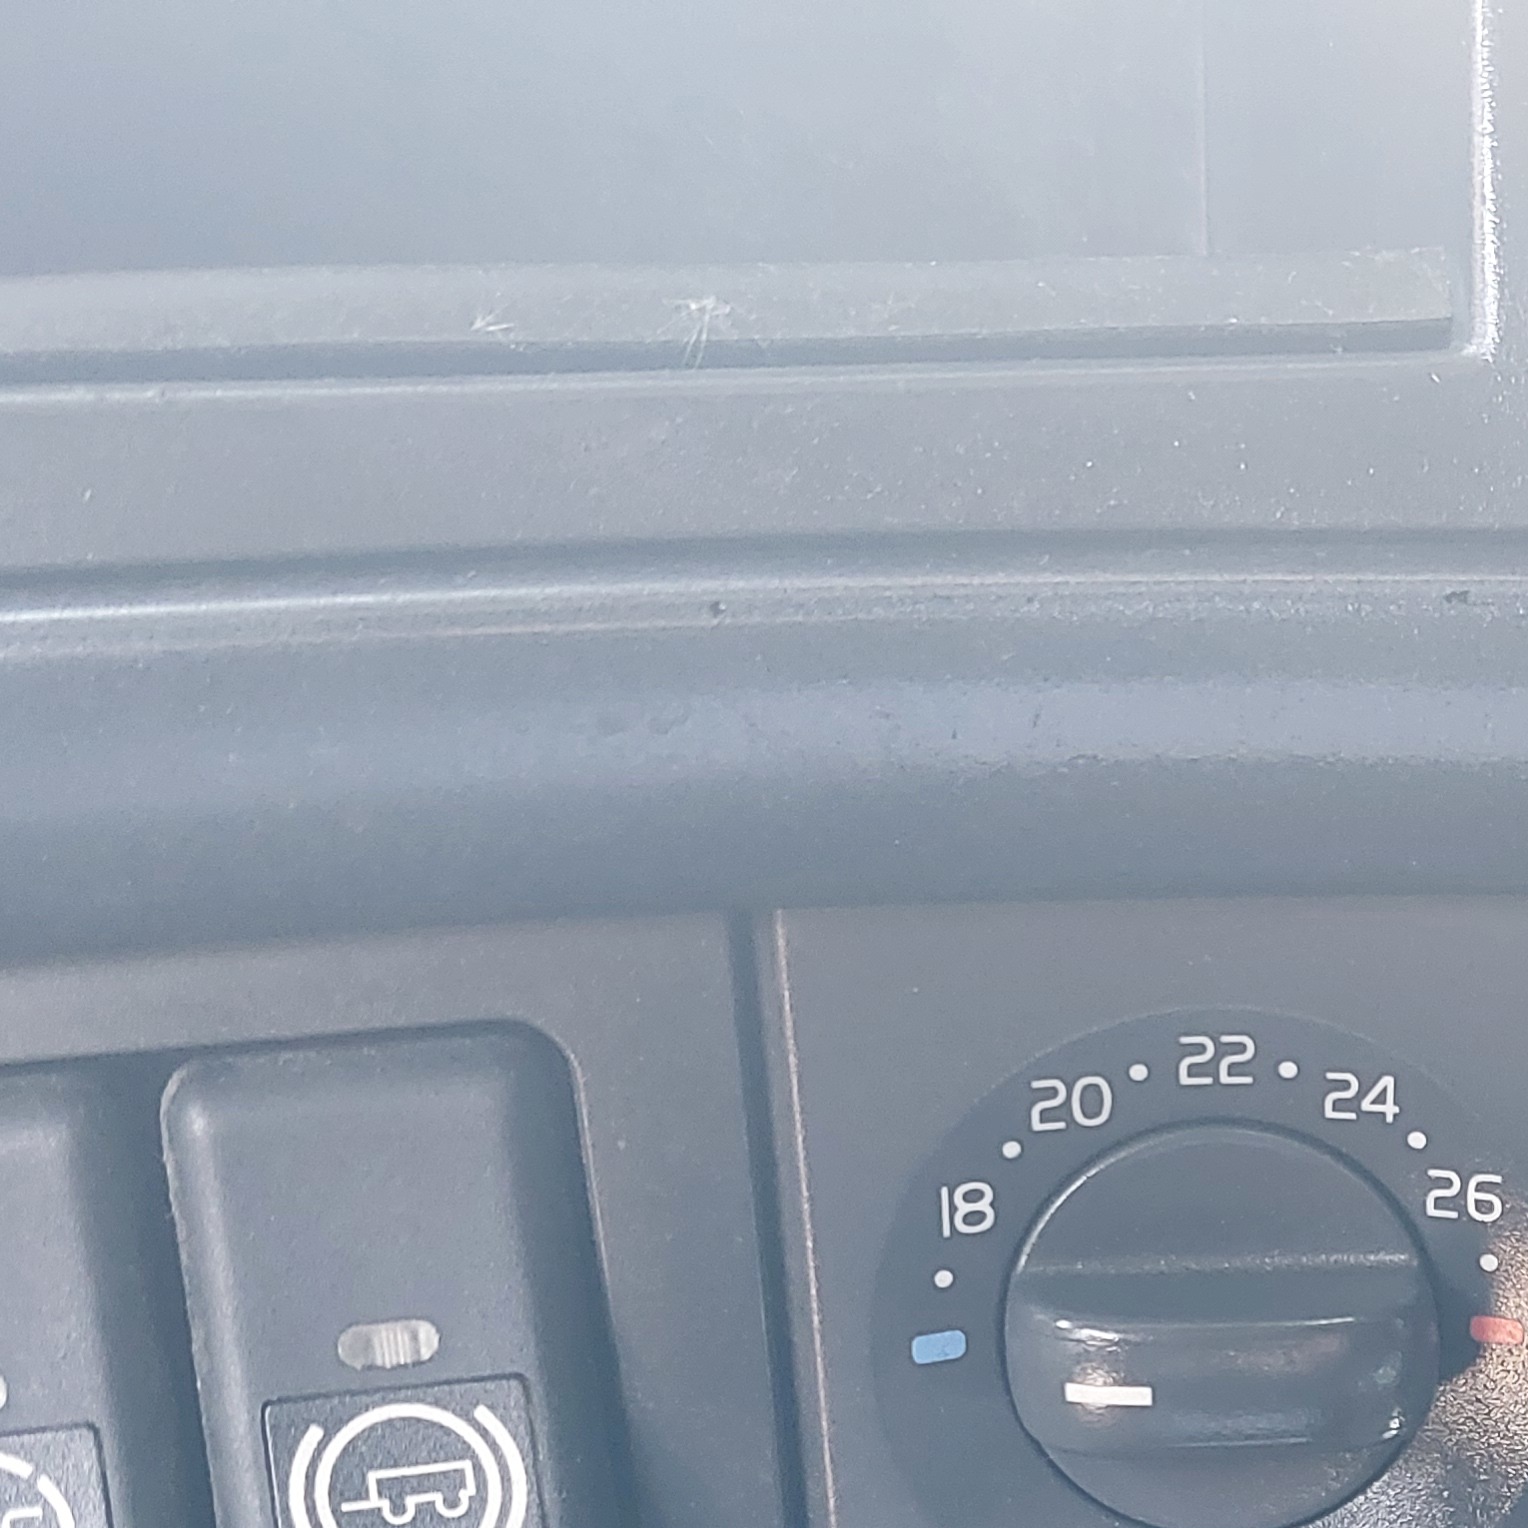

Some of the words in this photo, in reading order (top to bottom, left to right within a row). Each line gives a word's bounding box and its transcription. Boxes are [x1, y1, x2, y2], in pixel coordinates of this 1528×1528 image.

[1178, 1034, 1256, 1086] 22
[1030, 1075, 1113, 1133] 20
[1323, 1071, 1400, 1124] 24
[940, 1182, 995, 1238] 18
[1425, 1169, 1502, 1222] 26
